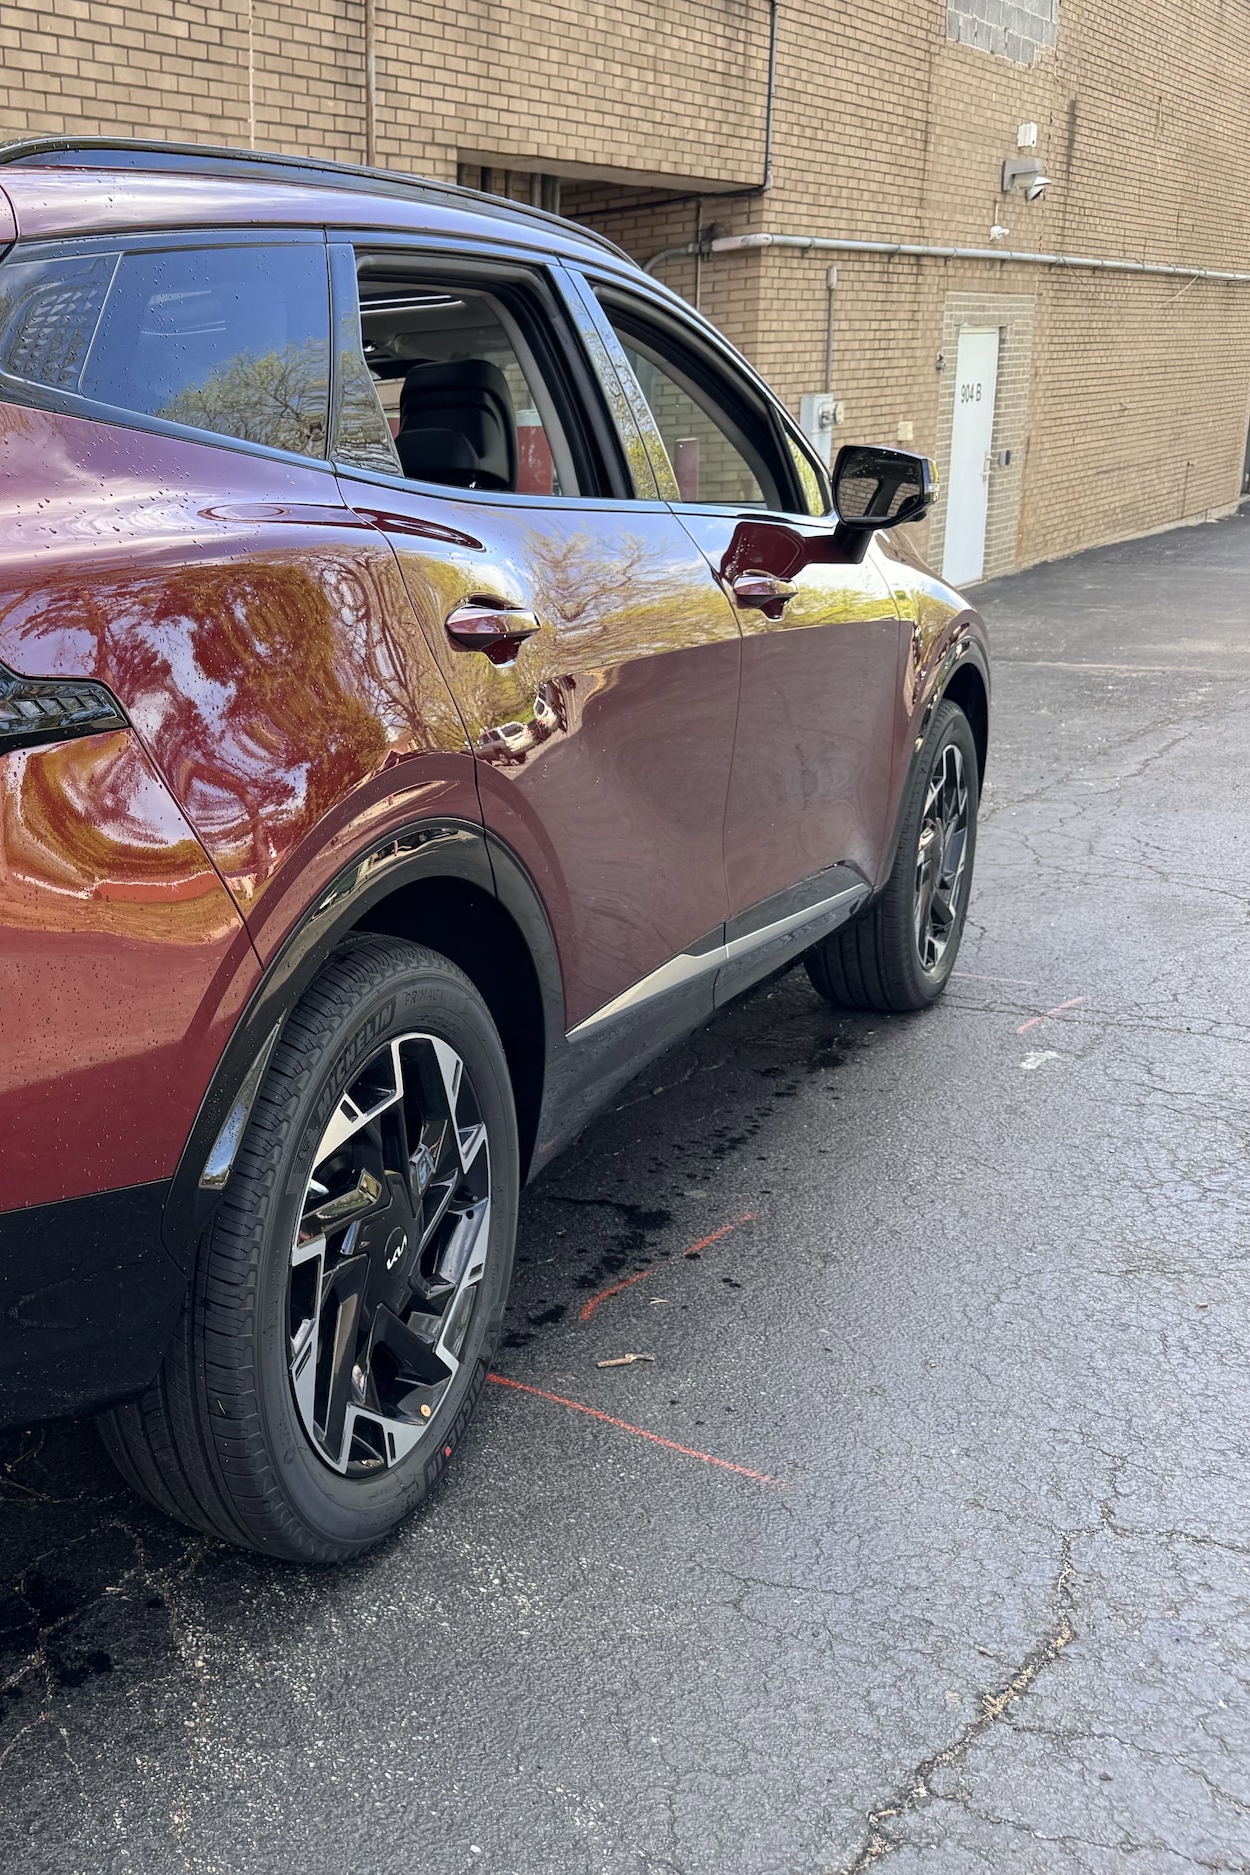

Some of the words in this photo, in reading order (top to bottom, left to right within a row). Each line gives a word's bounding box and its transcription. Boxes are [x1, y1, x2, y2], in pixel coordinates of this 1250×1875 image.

[960, 383, 974, 403] 904
[976, 383, 982, 402] B
[317, 1003, 392, 1123] MICHELIN
